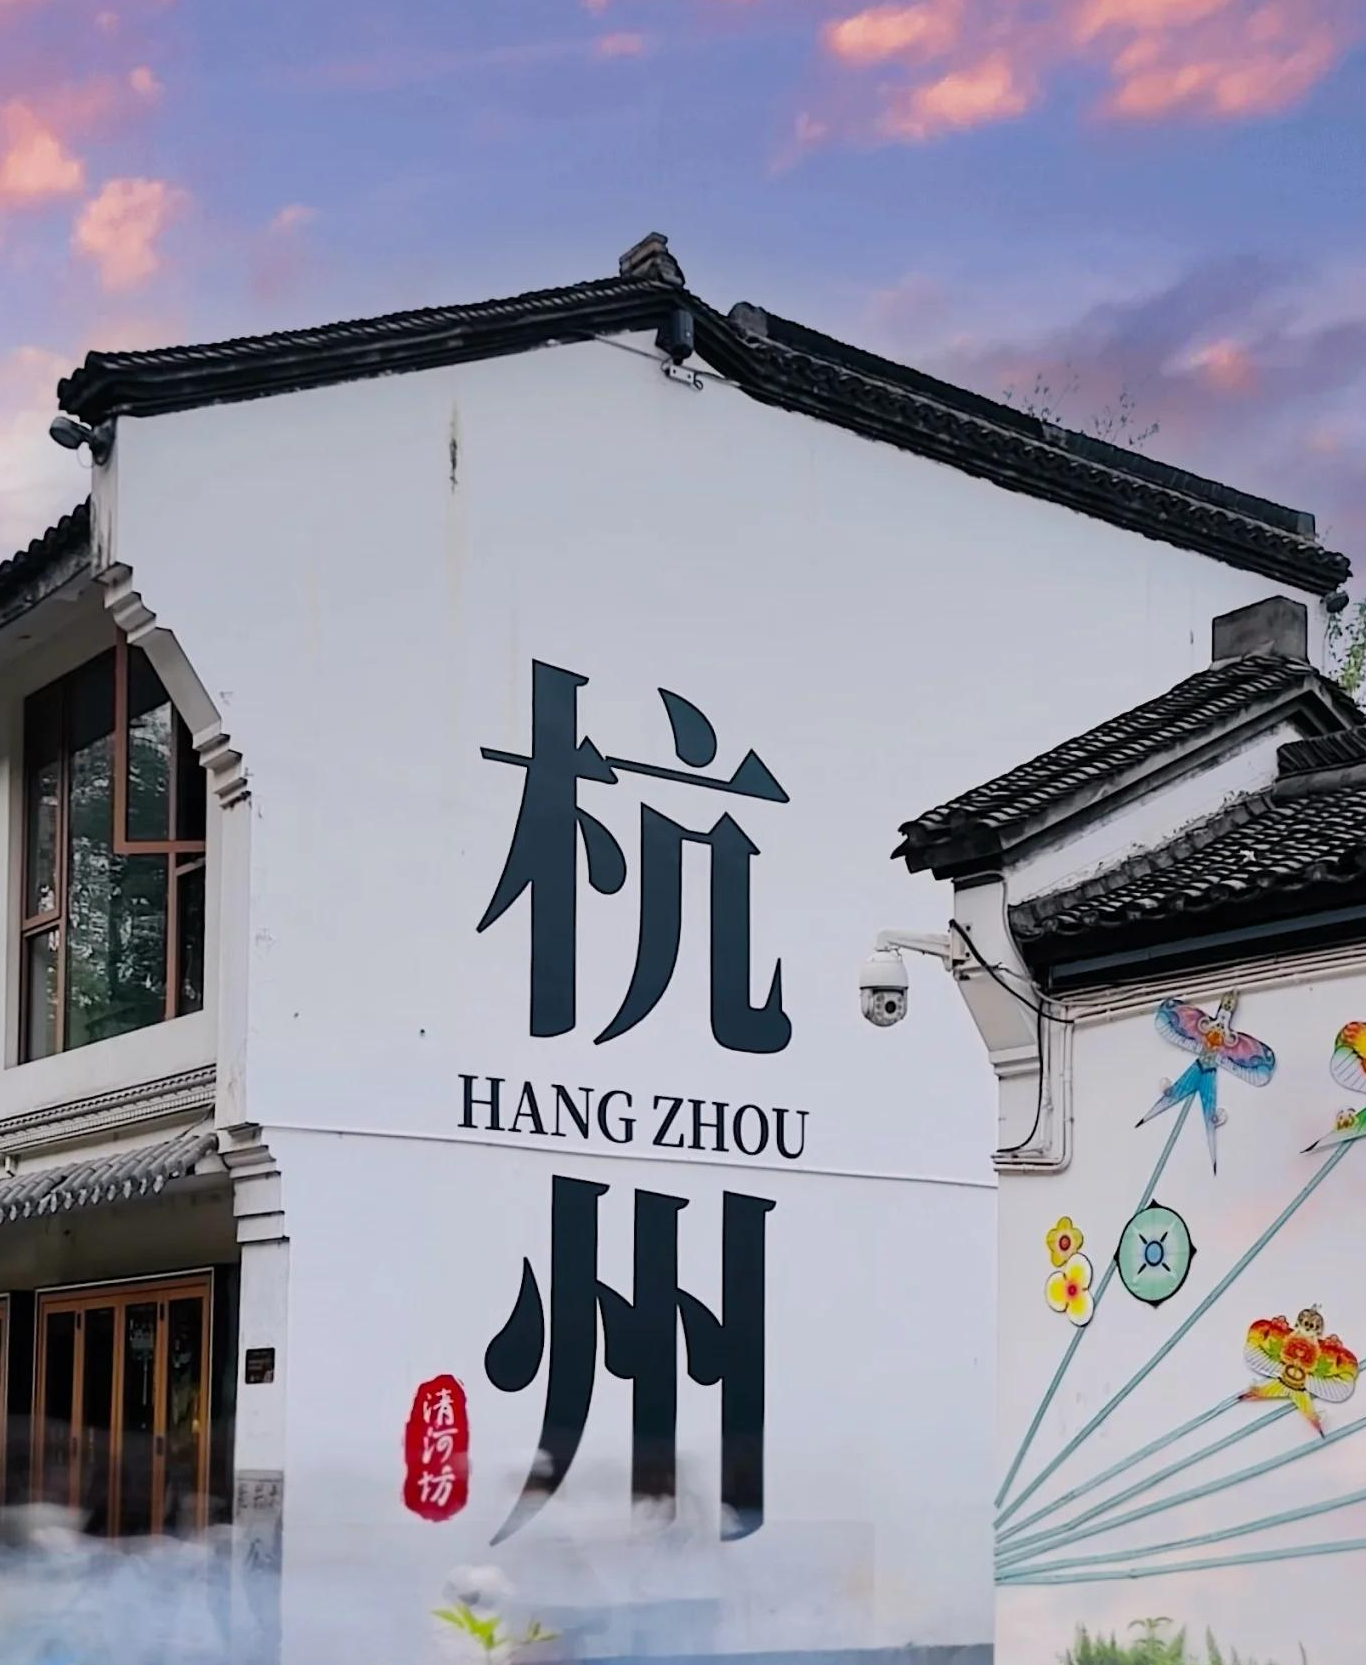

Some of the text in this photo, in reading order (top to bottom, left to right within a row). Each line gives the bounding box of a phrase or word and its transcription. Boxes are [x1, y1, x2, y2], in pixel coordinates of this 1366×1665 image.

[477, 660, 792, 1054] 杭
[457, 1074, 809, 1159] HANG ZHOU
[417, 1388, 459, 1507] 清河坊
[485, 1175, 776, 1546] 州
